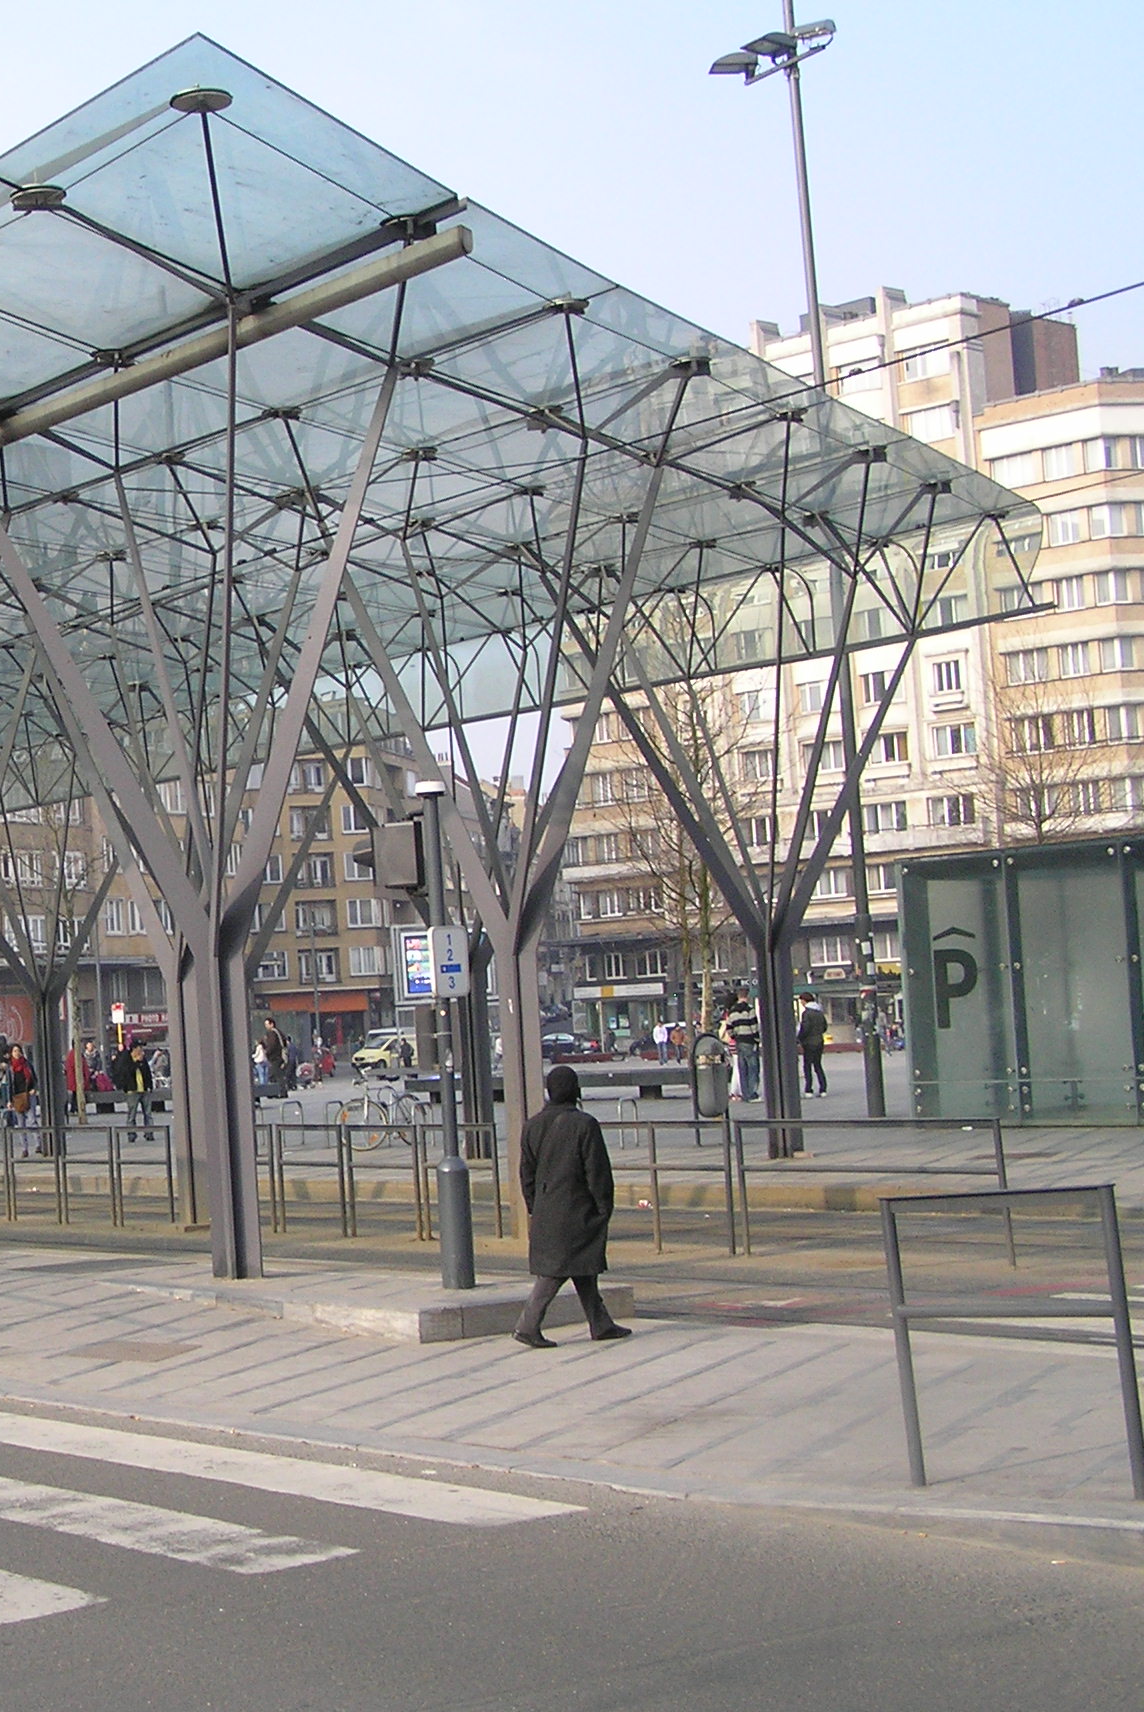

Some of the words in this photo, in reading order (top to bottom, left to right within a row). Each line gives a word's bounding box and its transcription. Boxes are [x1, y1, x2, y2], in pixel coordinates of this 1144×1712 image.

[446, 934, 452, 945] 1
[446, 949, 454, 961] 2
[448, 976, 456, 989] 3
[934, 948, 977, 1029] P
